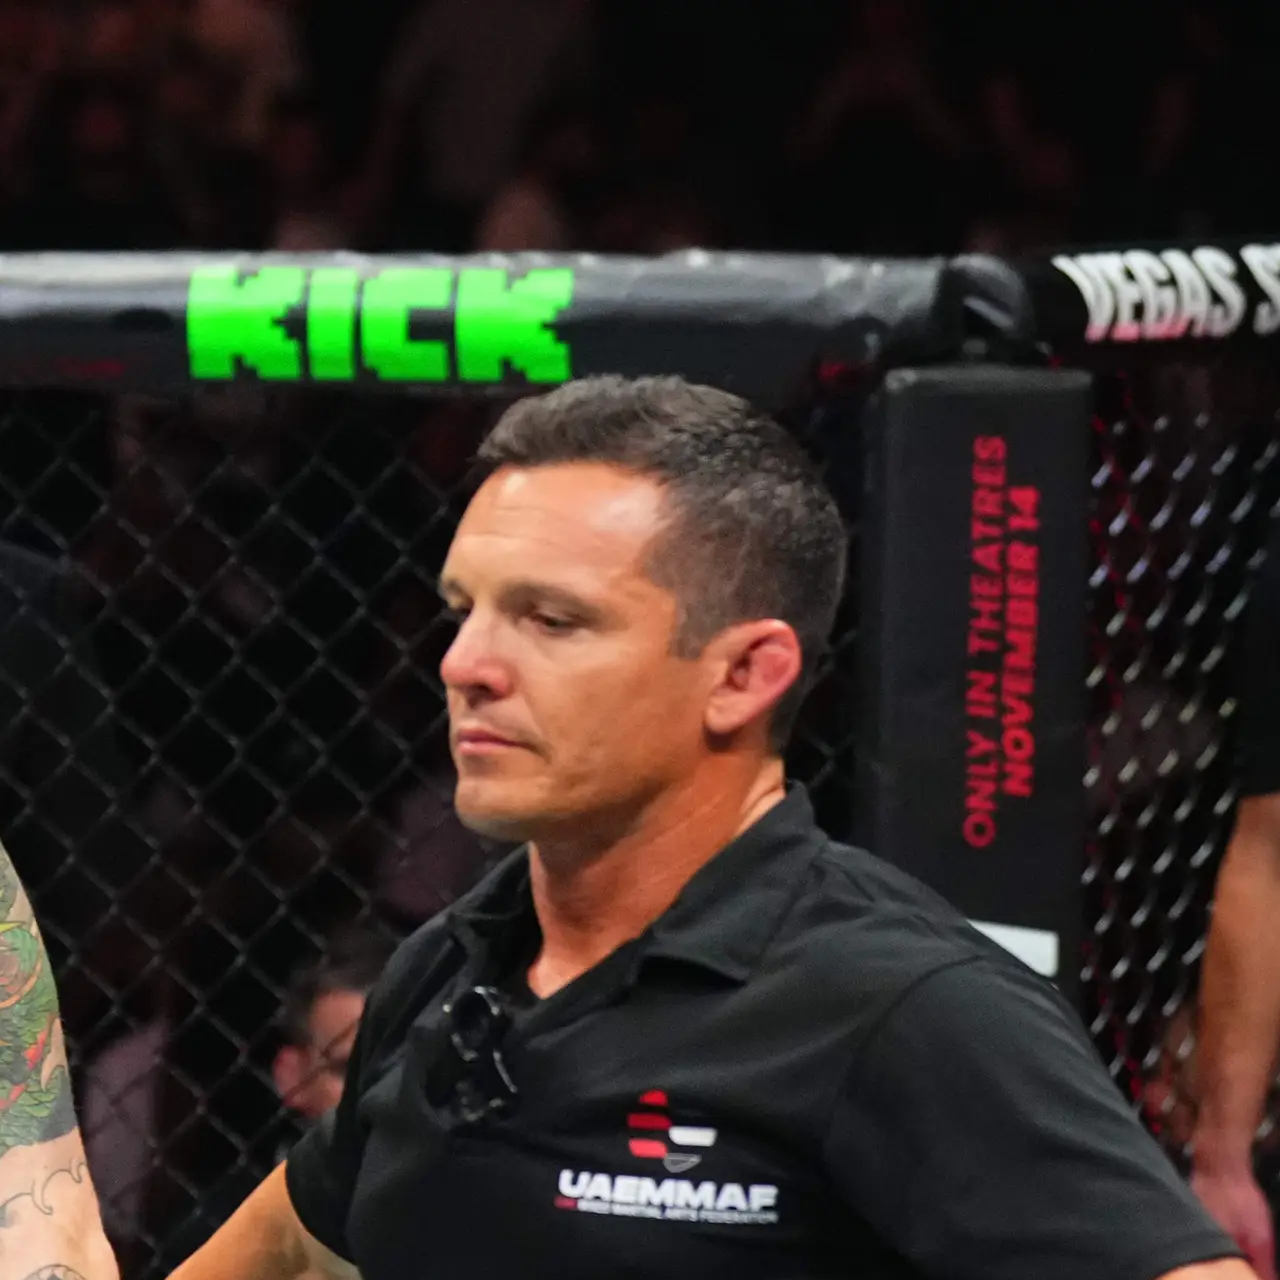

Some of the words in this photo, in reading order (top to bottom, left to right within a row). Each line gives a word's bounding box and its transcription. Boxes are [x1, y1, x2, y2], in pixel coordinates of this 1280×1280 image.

[186, 264, 573, 382] KICK
[1051, 246, 1244, 341] VEGAS
[968, 435, 1007, 655] THEATRES
[1008, 486, 1040, 529] 14
[965, 669, 998, 716] IN
[1001, 543, 1039, 798] NOVEMBER
[963, 732, 999, 848] ONLY
[558, 1169, 778, 1212] UAEMMAF
